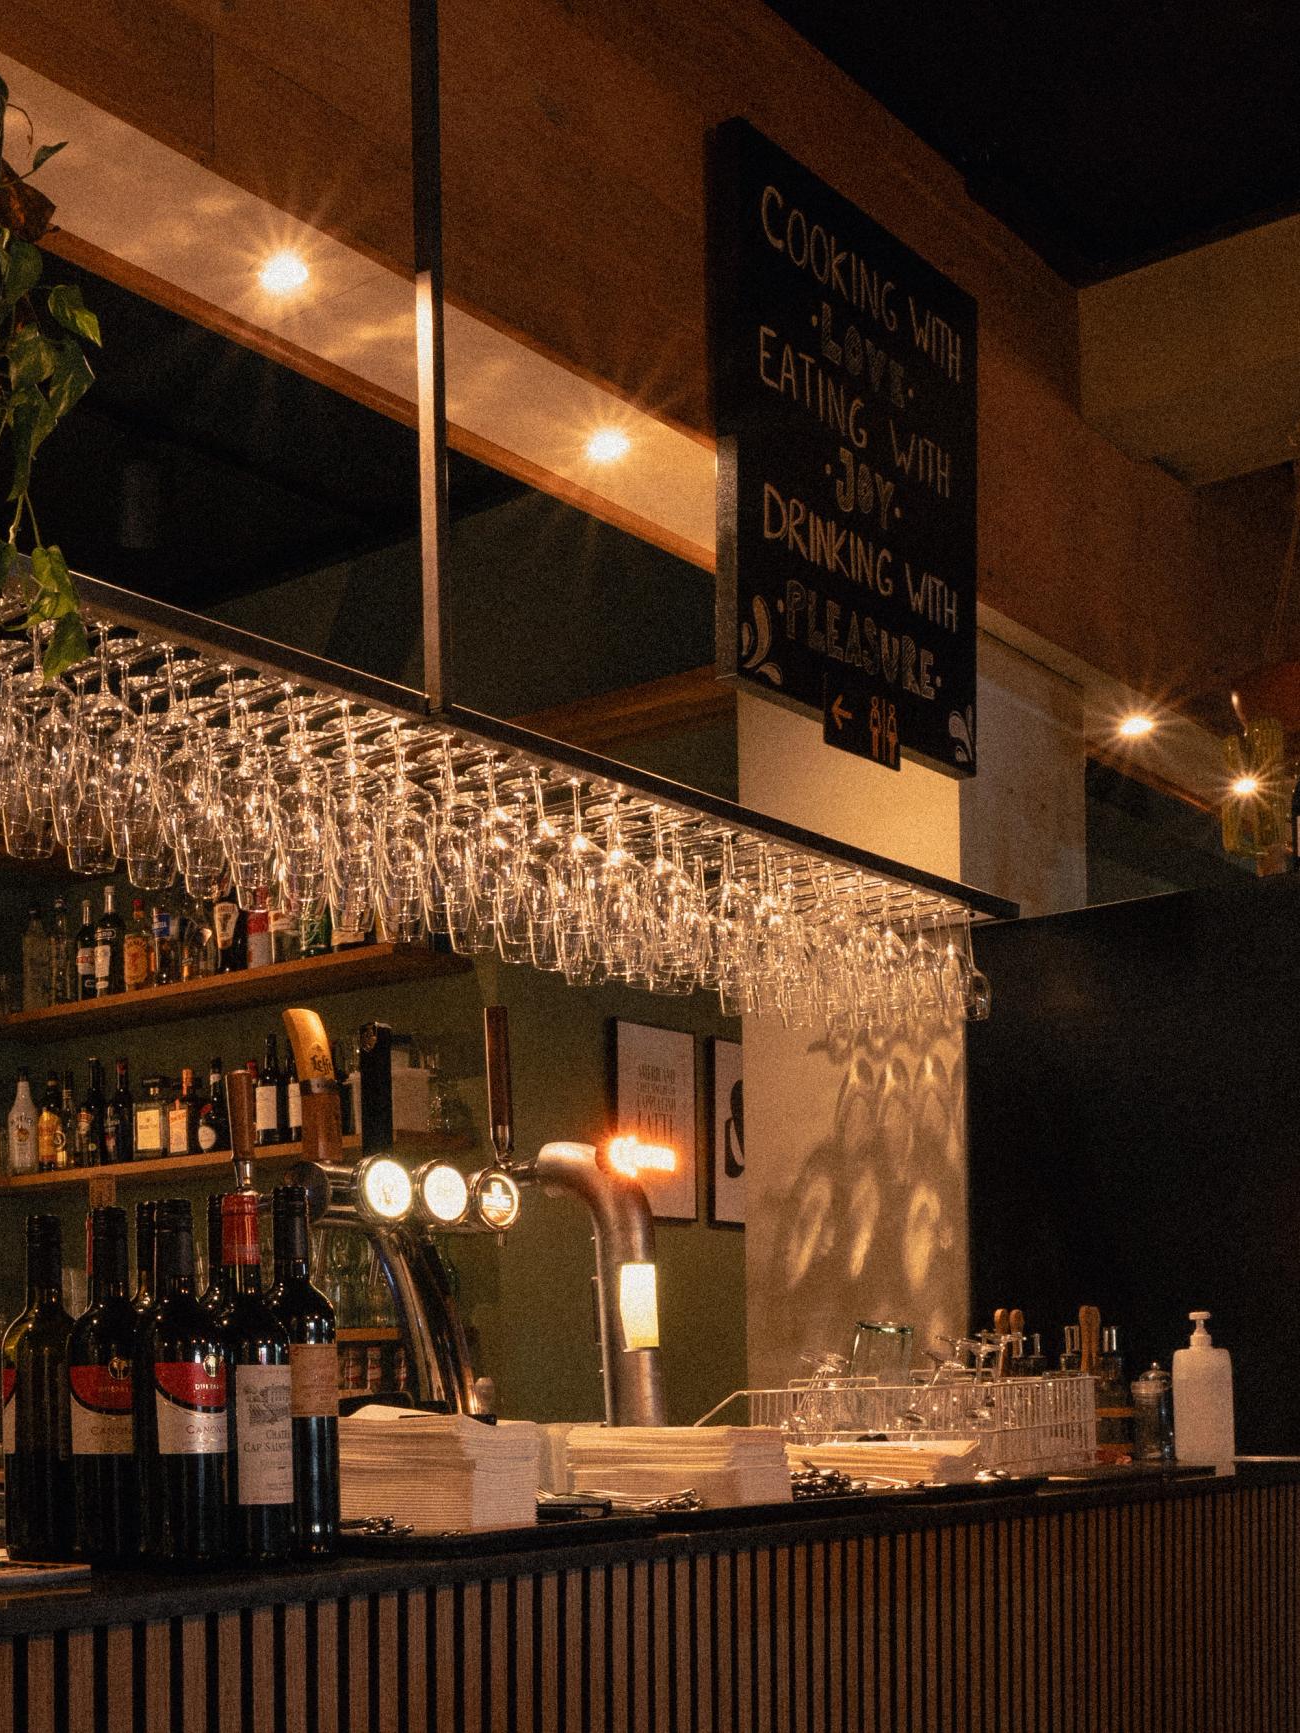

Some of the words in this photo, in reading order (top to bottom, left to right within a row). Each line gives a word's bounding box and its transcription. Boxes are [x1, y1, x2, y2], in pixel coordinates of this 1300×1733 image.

[760, 184, 897, 334] COOKING
[909, 294, 962, 383] WITH
[758, 325, 868, 449] EATING
[891, 417, 952, 499] WITH
[817, 302, 908, 409] LOVE
[834, 445, 896, 531] JOY
[763, 483, 894, 598] DRINKING
[906, 561, 960, 634] WITH
[785, 579, 936, 700] PLEASURE
